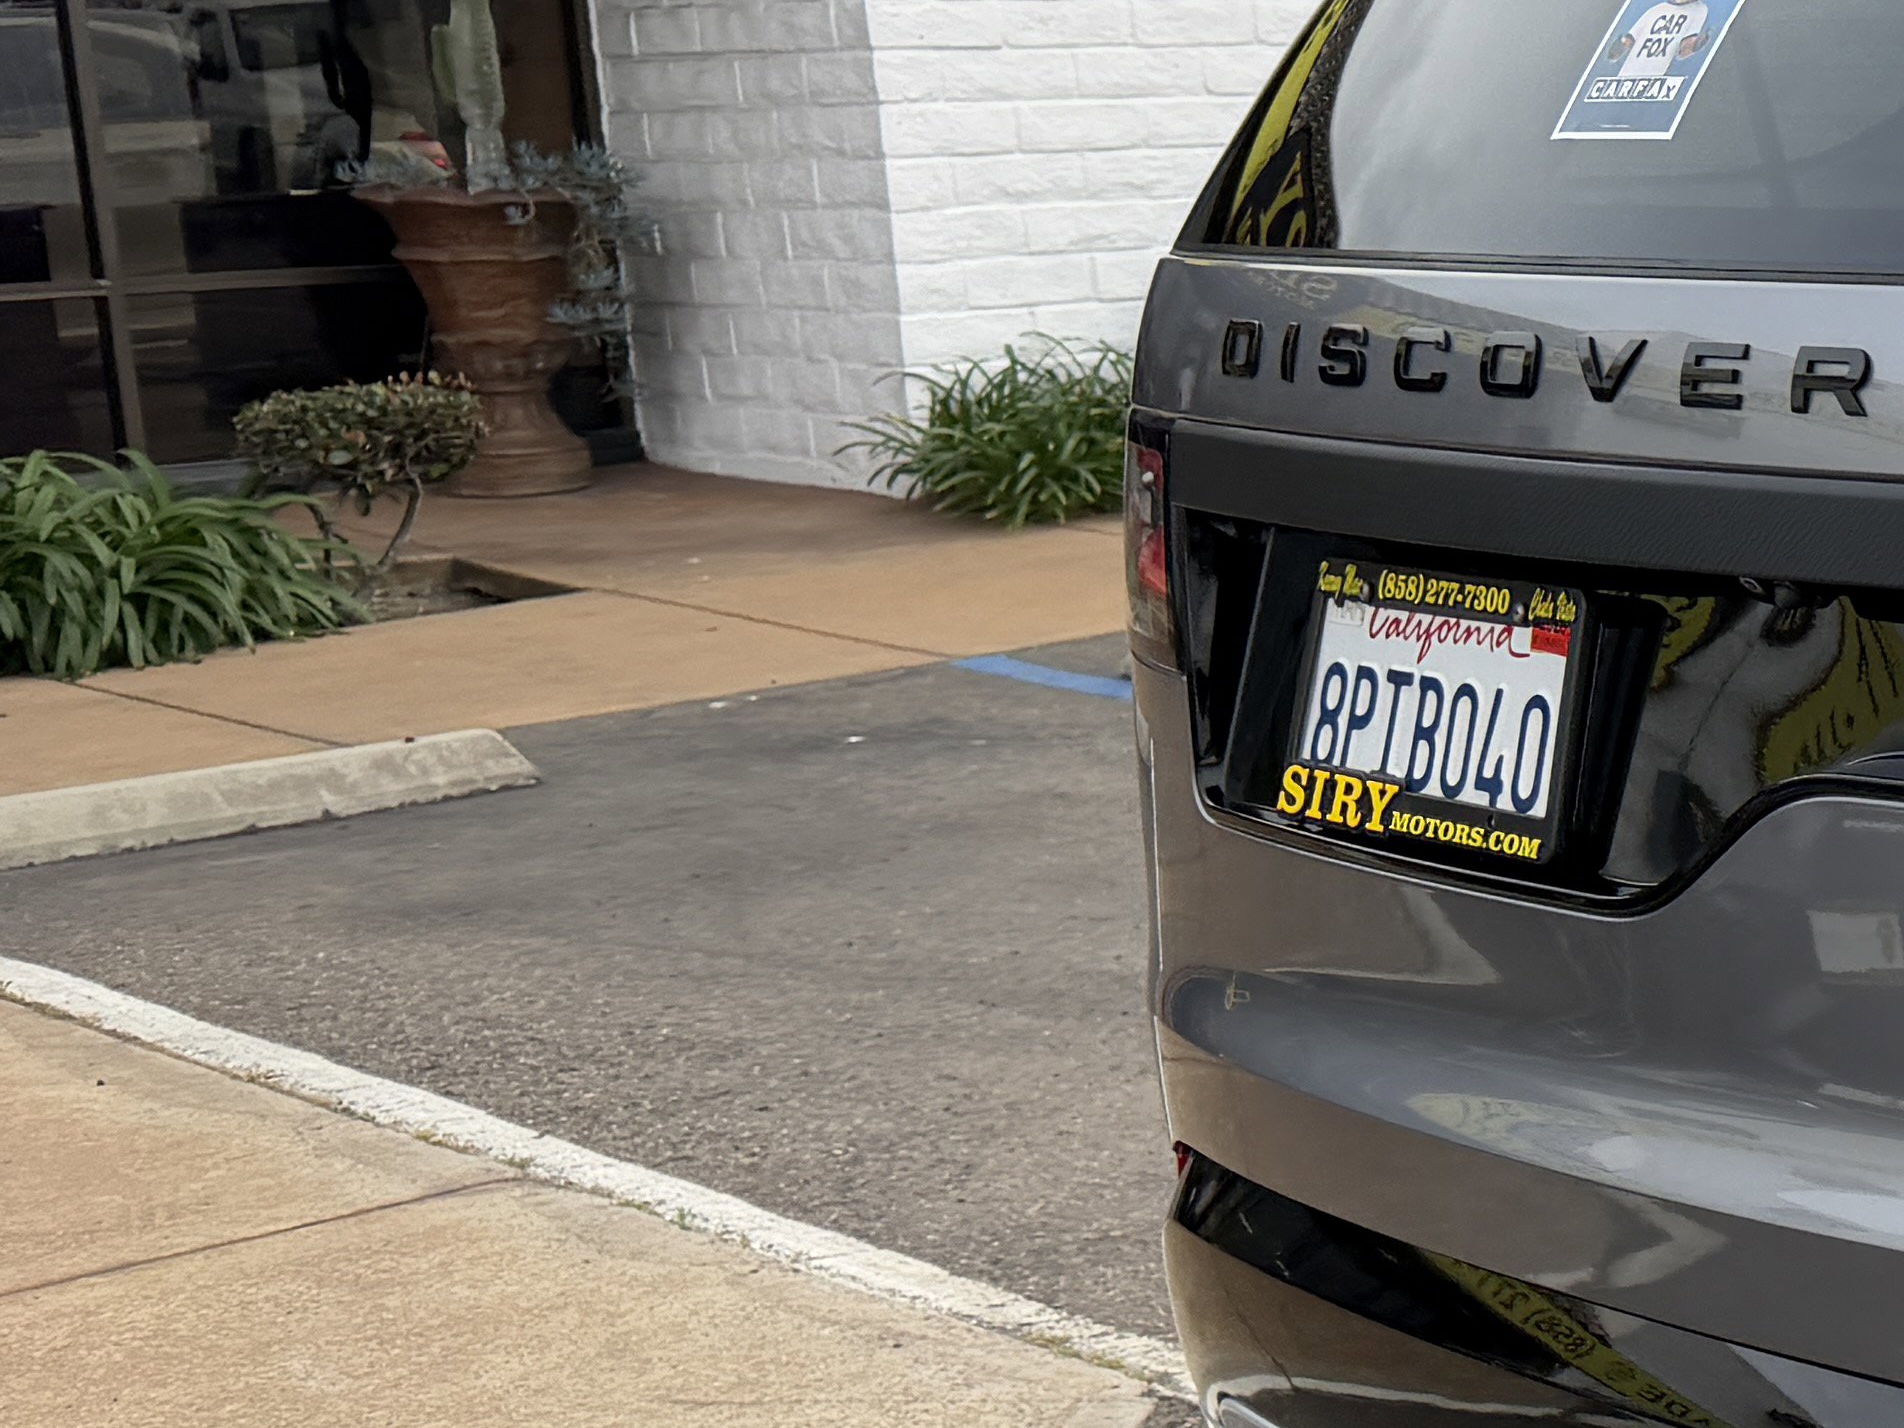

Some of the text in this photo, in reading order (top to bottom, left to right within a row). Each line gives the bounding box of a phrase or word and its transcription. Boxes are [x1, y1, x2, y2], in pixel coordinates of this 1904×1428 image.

[1650, 14, 1687, 35] CAR
[1636, 36, 1675, 59] FOX
[1588, 77, 1680, 101] CARFAX
[1378, 569, 1425, 604] (858)
[1368, 606, 1531, 664] California
[1310, 661, 1551, 814] 8PTB040
[1276, 764, 1542, 860] SIRY MOTORS.COM
